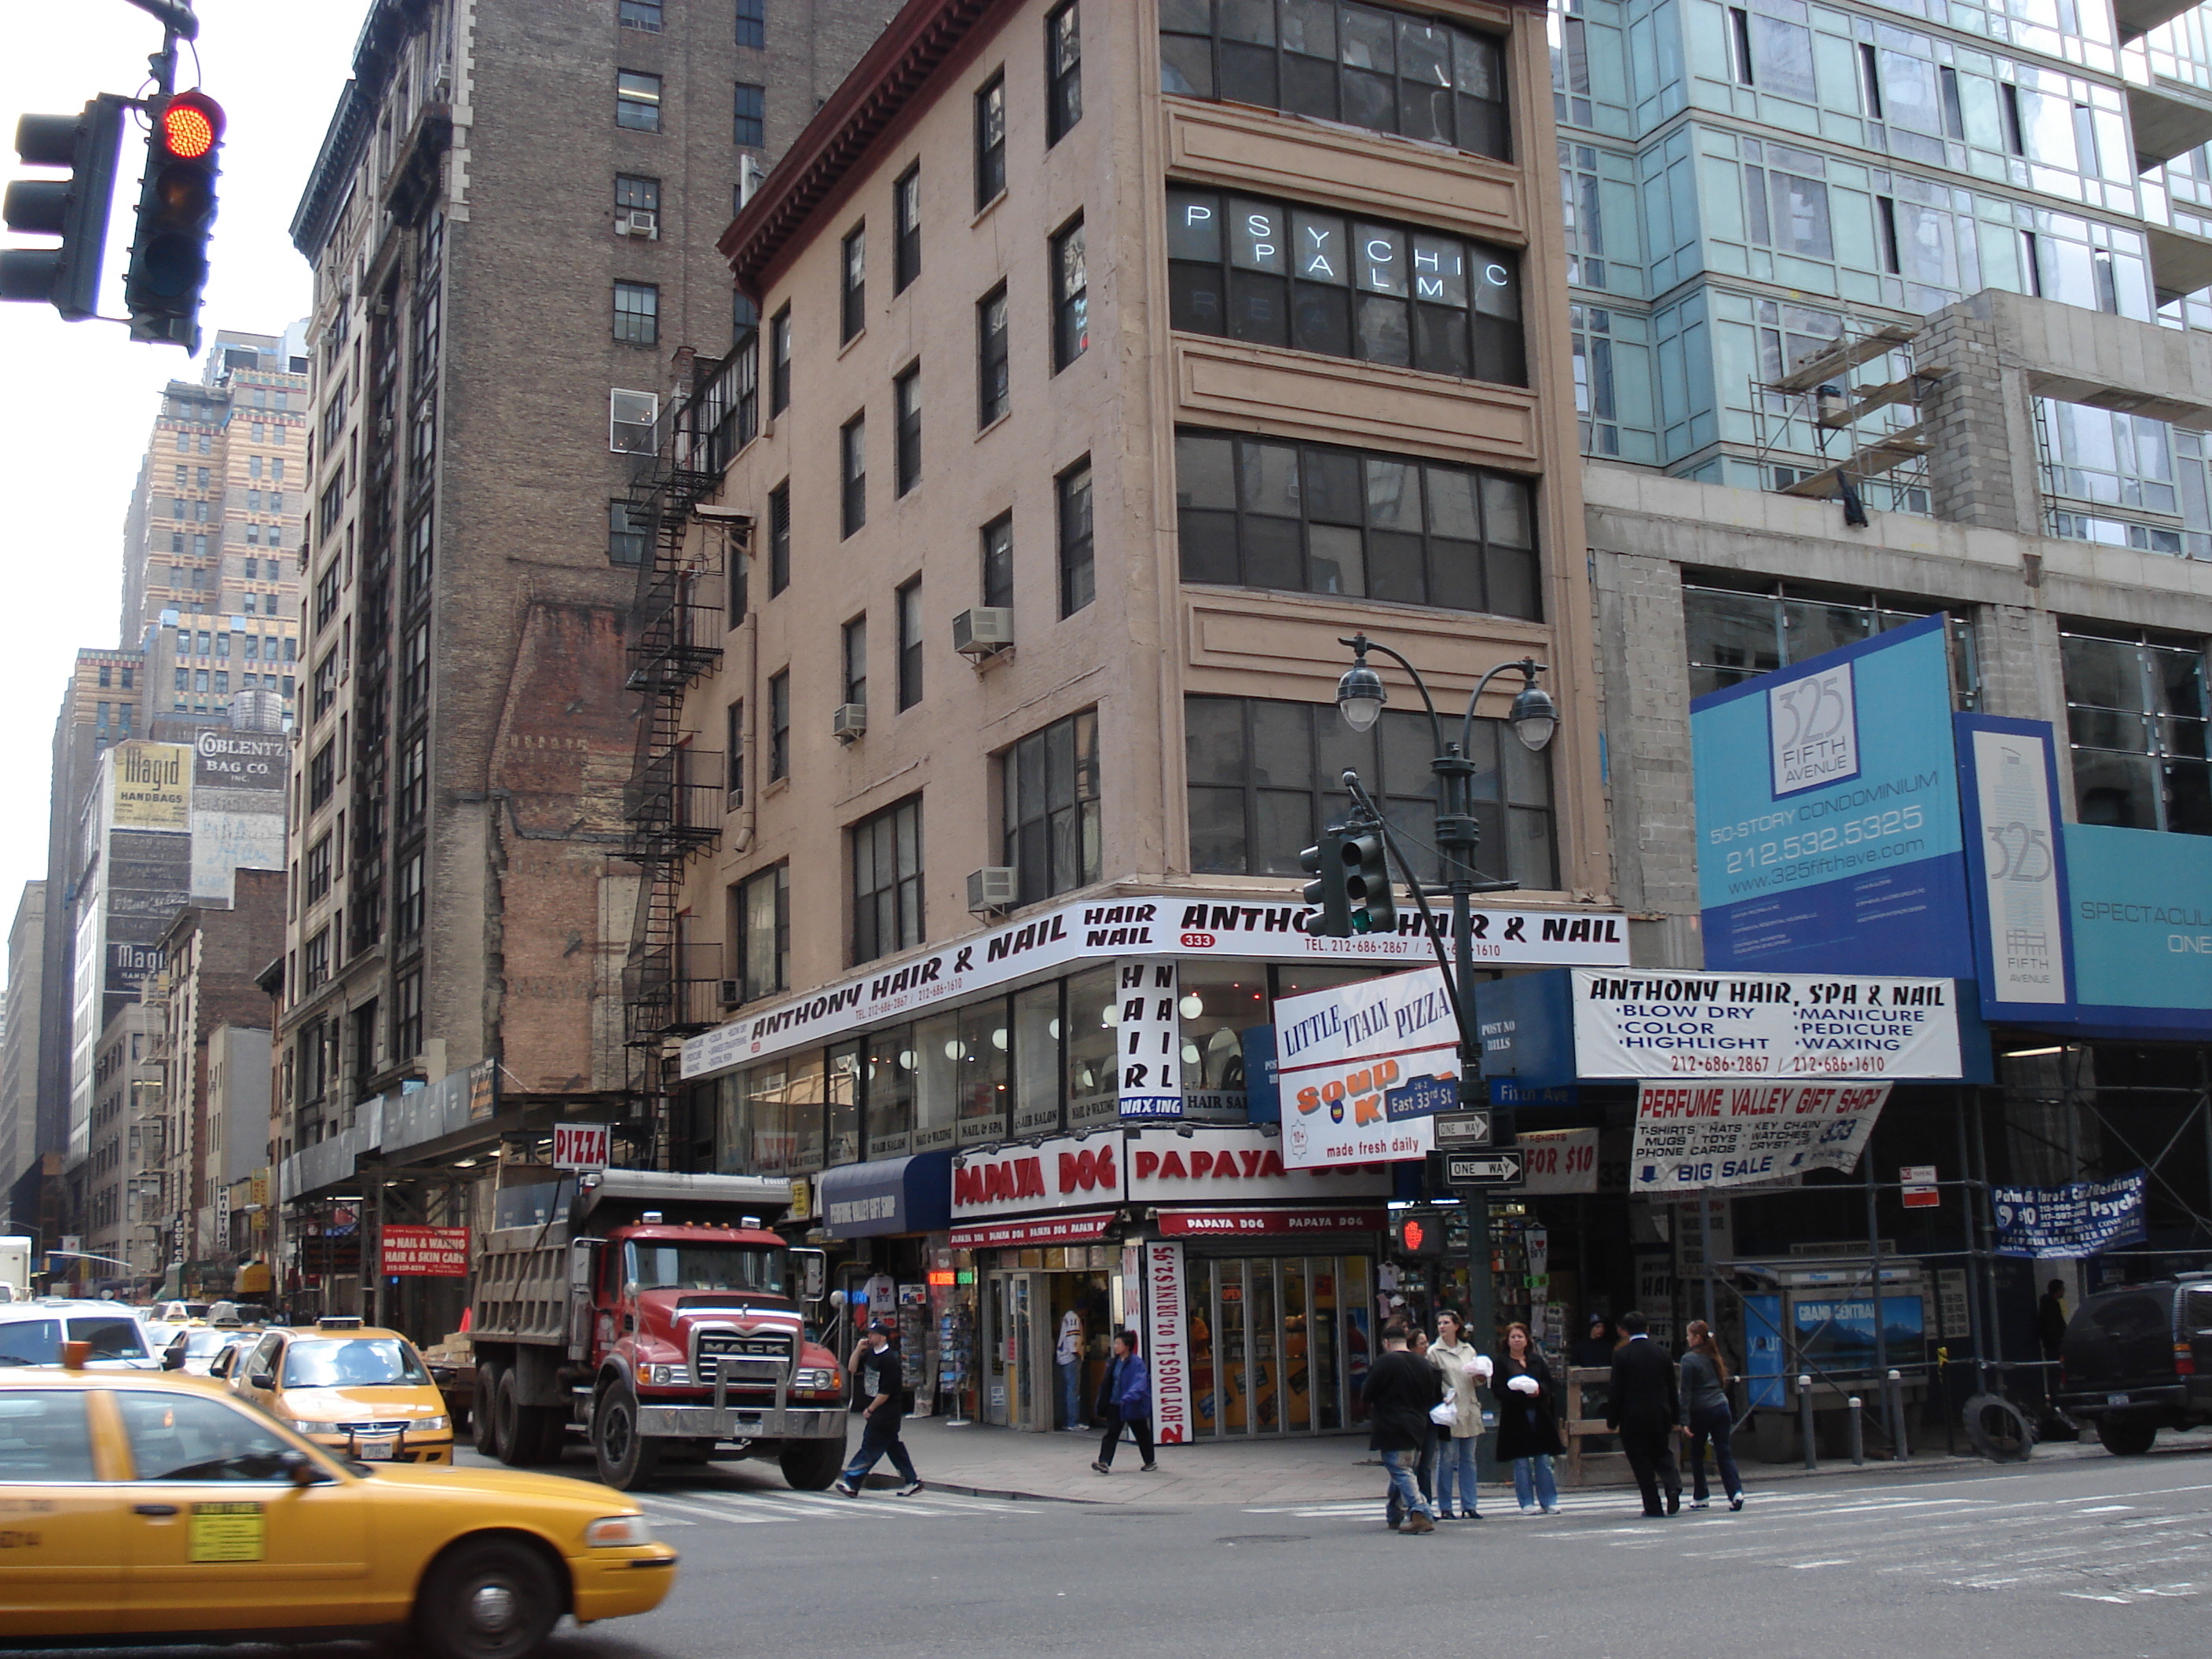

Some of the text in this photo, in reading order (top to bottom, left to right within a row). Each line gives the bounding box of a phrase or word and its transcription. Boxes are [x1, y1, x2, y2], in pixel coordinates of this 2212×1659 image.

[1188, 205, 1507, 287] PSYCHIC
[1255, 244, 1443, 298] PALM
[1779, 677, 1844, 750] 325
[198, 732, 285, 757] COBLENTZ
[1783, 736, 1846, 769] FIFTH
[125, 749, 180, 791] Magid
[206, 760, 241, 773] BAG
[1785, 755, 1848, 784] AVENUE
[121, 792, 182, 804] HANDBAGS
[1710, 771, 1938, 844] 50-STORY CONDOMINIUM
[1727, 804, 1924, 874] 212.532.5325
[1987, 822, 2053, 882] 325
[1729, 839, 1925, 895] www.325fifthave.com
[1084, 903, 1157, 925] HAIR
[1181, 903, 1360, 933] ANTHO
[1503, 917, 1527, 943] &
[1542, 918, 1621, 943] NAIL
[2081, 902, 2212, 926] SPECTACUL
[1086, 928, 1153, 947] NAIL
[1185, 935, 1211, 947] 333
[1305, 939, 1328, 951] TEL.
[2168, 935, 2212, 954] ONE
[118, 945, 164, 973] Magi
[2008, 958, 2049, 971] FIFTH
[752, 914, 1068, 1040] ANTHONY HAIR & NAIL
[2009, 974, 2050, 983] AVENUE
[1590, 978, 1945, 1007] ANTHONY HAIR, SPA & NAIL
[1284, 987, 1451, 1058] LITTLE ITALY PIZZA
[1708, 1006, 1756, 1020] DRY
[1800, 1008, 1925, 1023] MANICURE
[1122, 965, 1148, 1088] HAIR
[1155, 965, 1174, 1088] NAIL
[1481, 1020, 1515, 1036] POST NO
[1624, 1022, 1716, 1035] COLOR
[1803, 1023, 1914, 1037] PEDICURE
[1487, 1038, 1511, 1051] BILLS
[1626, 1037, 1771, 1049] HIGHLIGHT
[1804, 1038, 1902, 1051] WAXING
[1296, 1060, 1399, 1115] SOUP
[1092, 1100, 1115, 1115] WAXING
[1187, 1096, 1222, 1108] HAIR
[1392, 1097, 1414, 1113] East
[1416, 1088, 1438, 1109] 33rd
[1441, 1088, 1452, 1105] St
[1640, 1088, 1883, 1119] PERFUME VALLEY GIFT SHOP
[1035, 1110, 1057, 1126] SALON
[962, 1124, 980, 1137] NAIL
[988, 1121, 1003, 1133] SPA
[1441, 1123, 1481, 1135] ONE WAY
[1639, 1126, 1695, 1136] T-SHIRTS
[1709, 1124, 1742, 1133] HATS
[1755, 1122, 1778, 1130] KEY
[1645, 1130, 1811, 1146] MUGS TOYS WATCHES
[556, 1130, 607, 1164] PIZZA
[1327, 1137, 1419, 1158] made fresh daily
[1636, 1145, 1736, 1158] PHONE CARDS
[1135, 1150, 1286, 1180] PAPAYA
[1454, 1161, 1511, 1174] ONE WAY
[1526, 1146, 1594, 1174] FOR $10
[1678, 1156, 1774, 1181] BIG SALE
[954, 1145, 1116, 1206] PAPAYA DOG
[1995, 1189, 2023, 1203] Palm
[2024, 1190, 2034, 1203] &
[2093, 1177, 2142, 1196] Readings
[1187, 1217, 1363, 1229] PAPAYA DOG PAPAYA DOG
[2018, 1207, 2036, 1225] $10
[1030, 1227, 1051, 1237] PAPAYA
[1053, 1225, 1067, 1235] DOG
[1071, 1223, 1094, 1233] PAPAYA
[397, 1238, 466, 1250] NAIL & WAXING
[385, 1251, 464, 1264] HAIR & SKIN CARE
[1153, 1247, 1174, 1282] $2.95
[1156, 1284, 1177, 1317] DRINK
[1798, 1305, 1831, 1321] GRAND
[704, 1343, 786, 1354] MACK
[1156, 1343, 1179, 1356] 14
[1159, 1359, 1182, 1393] DOGS
[1161, 1397, 1183, 1423] HOT
[1161, 1424, 1184, 1444] 2
